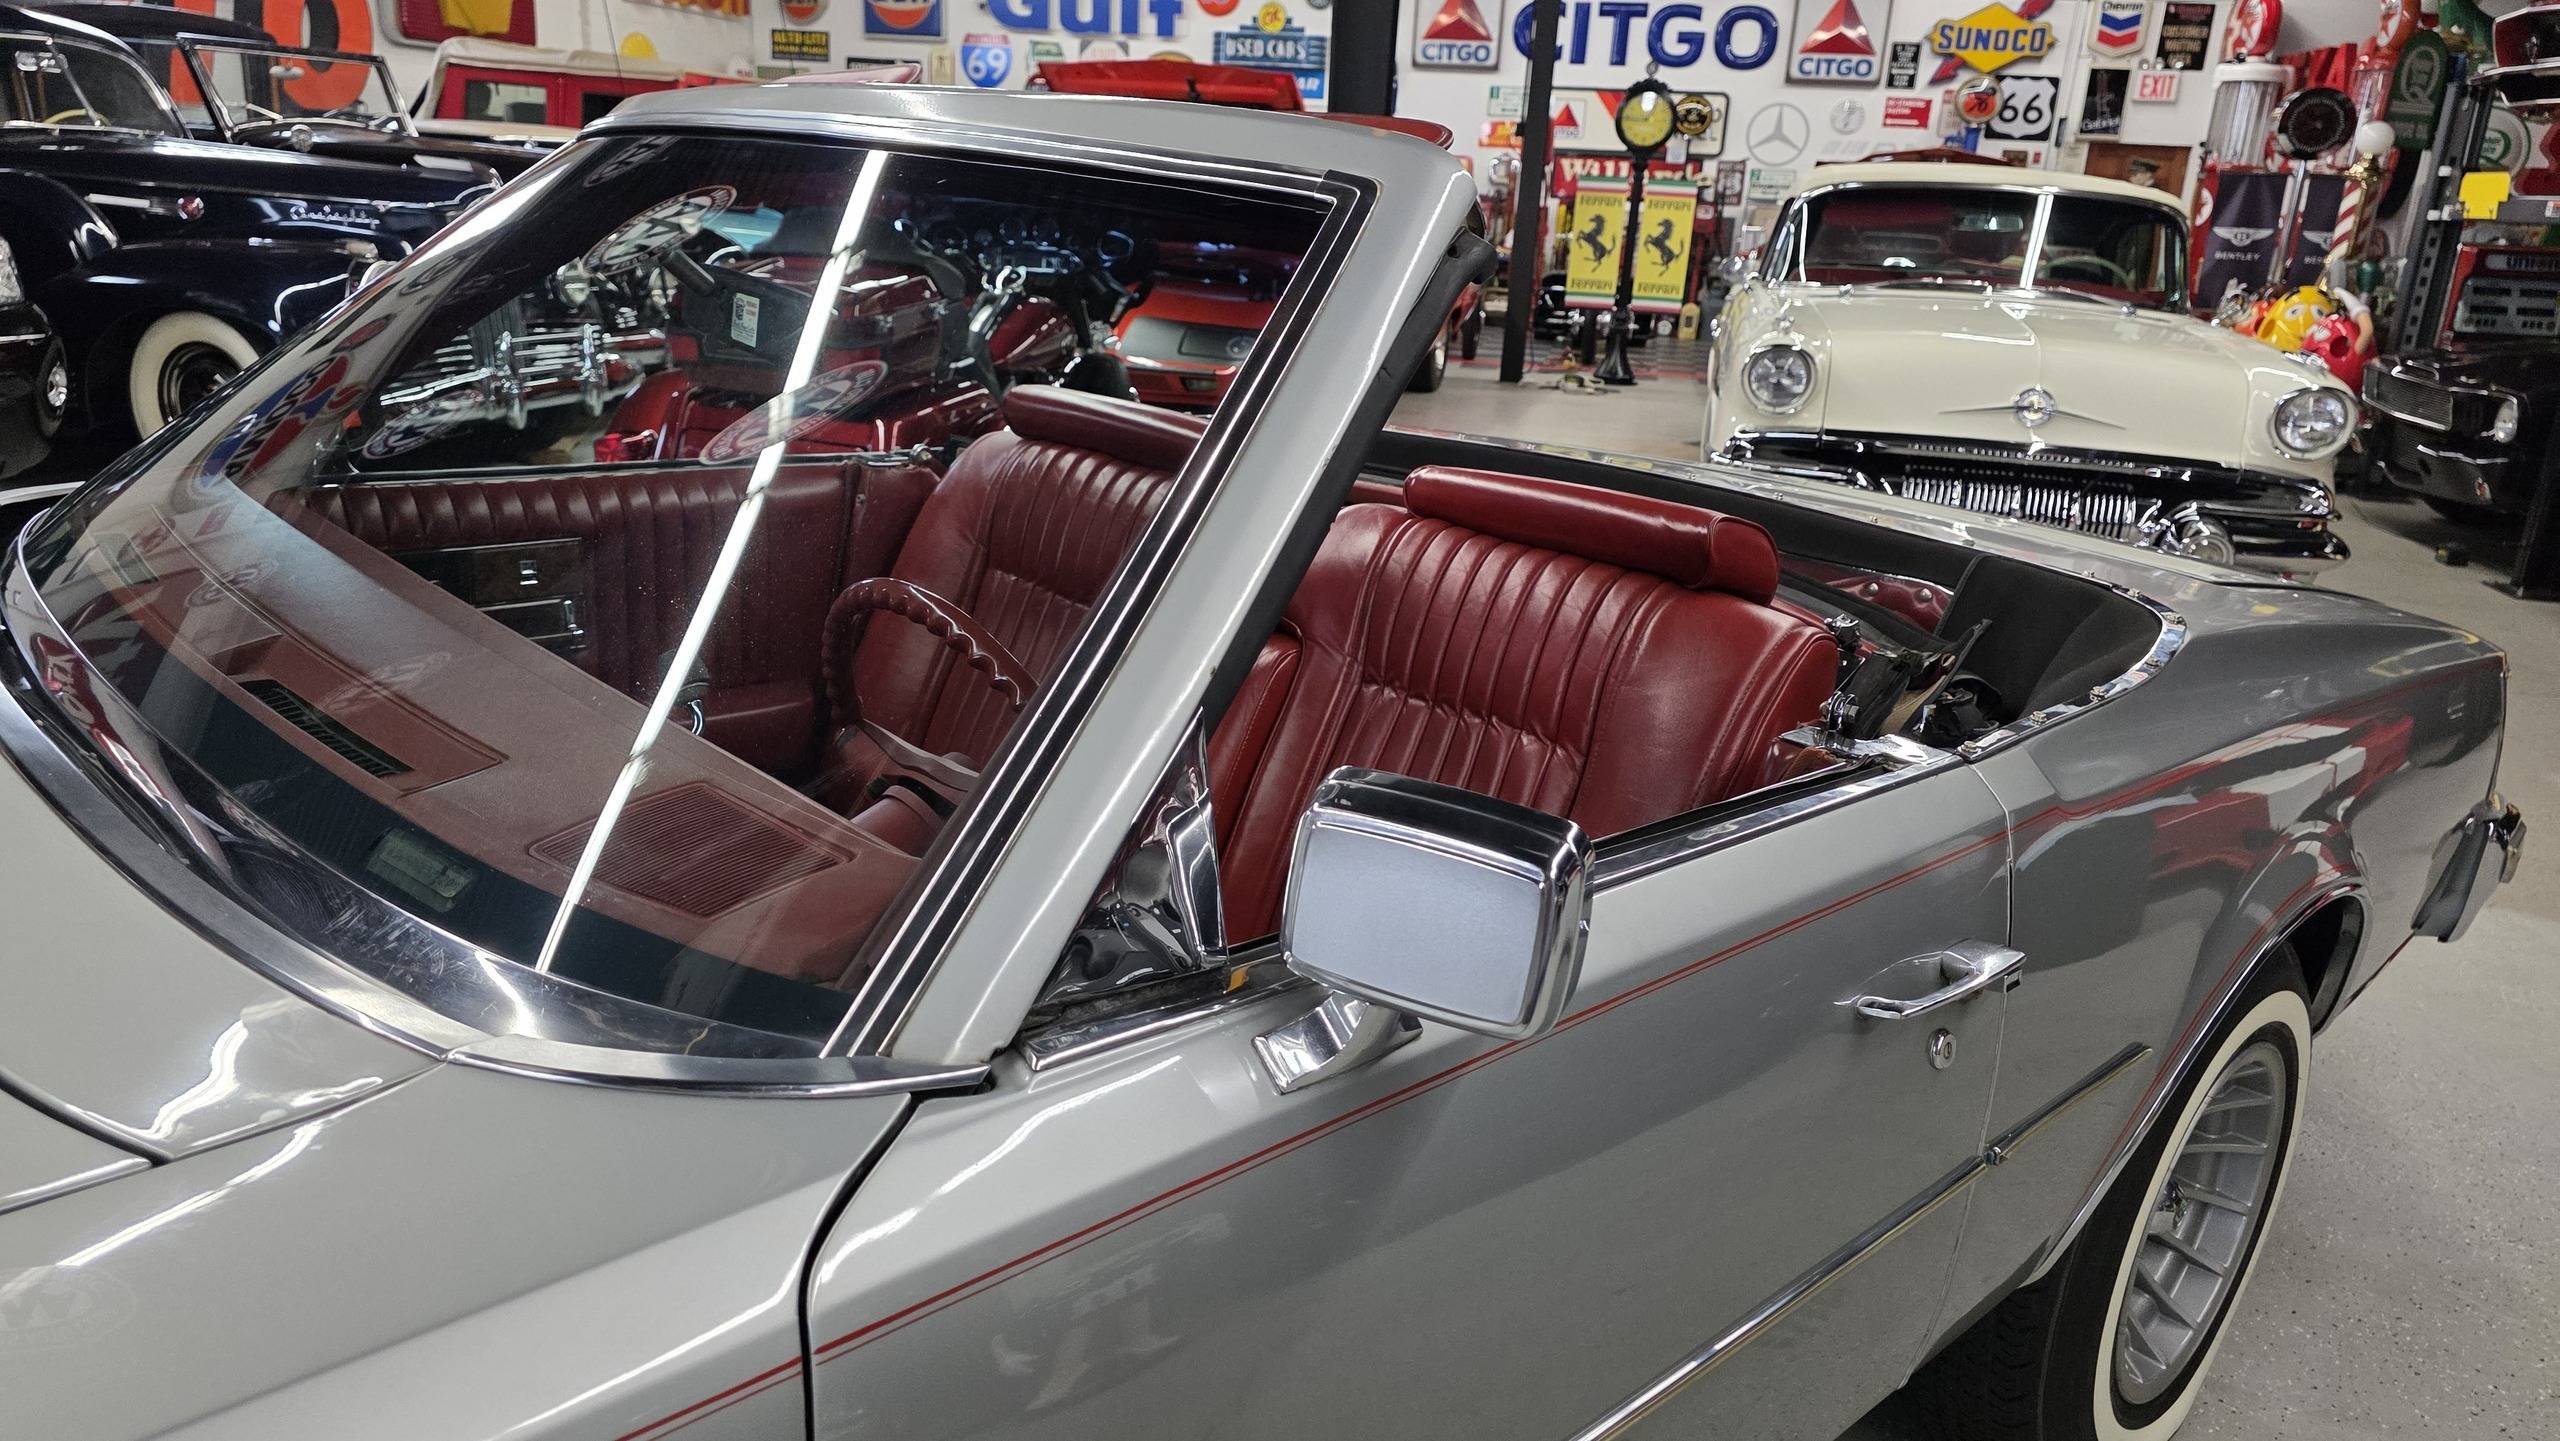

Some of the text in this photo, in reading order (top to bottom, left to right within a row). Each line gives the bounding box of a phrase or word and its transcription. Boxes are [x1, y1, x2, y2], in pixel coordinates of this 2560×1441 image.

[1514, 1, 1778, 70] CITGO
[1938, 24, 2047, 53] SUNOCO
[1225, 38, 1306, 61] USED CARS
[1421, 43, 1490, 62] CITGO
[967, 48, 1007, 80] 69
[1797, 57, 1873, 77] CITGO
[2140, 74, 2176, 98] EXIT
[1999, 92, 2043, 124] 66
[2214, 250, 2261, 262] BENTLEY
